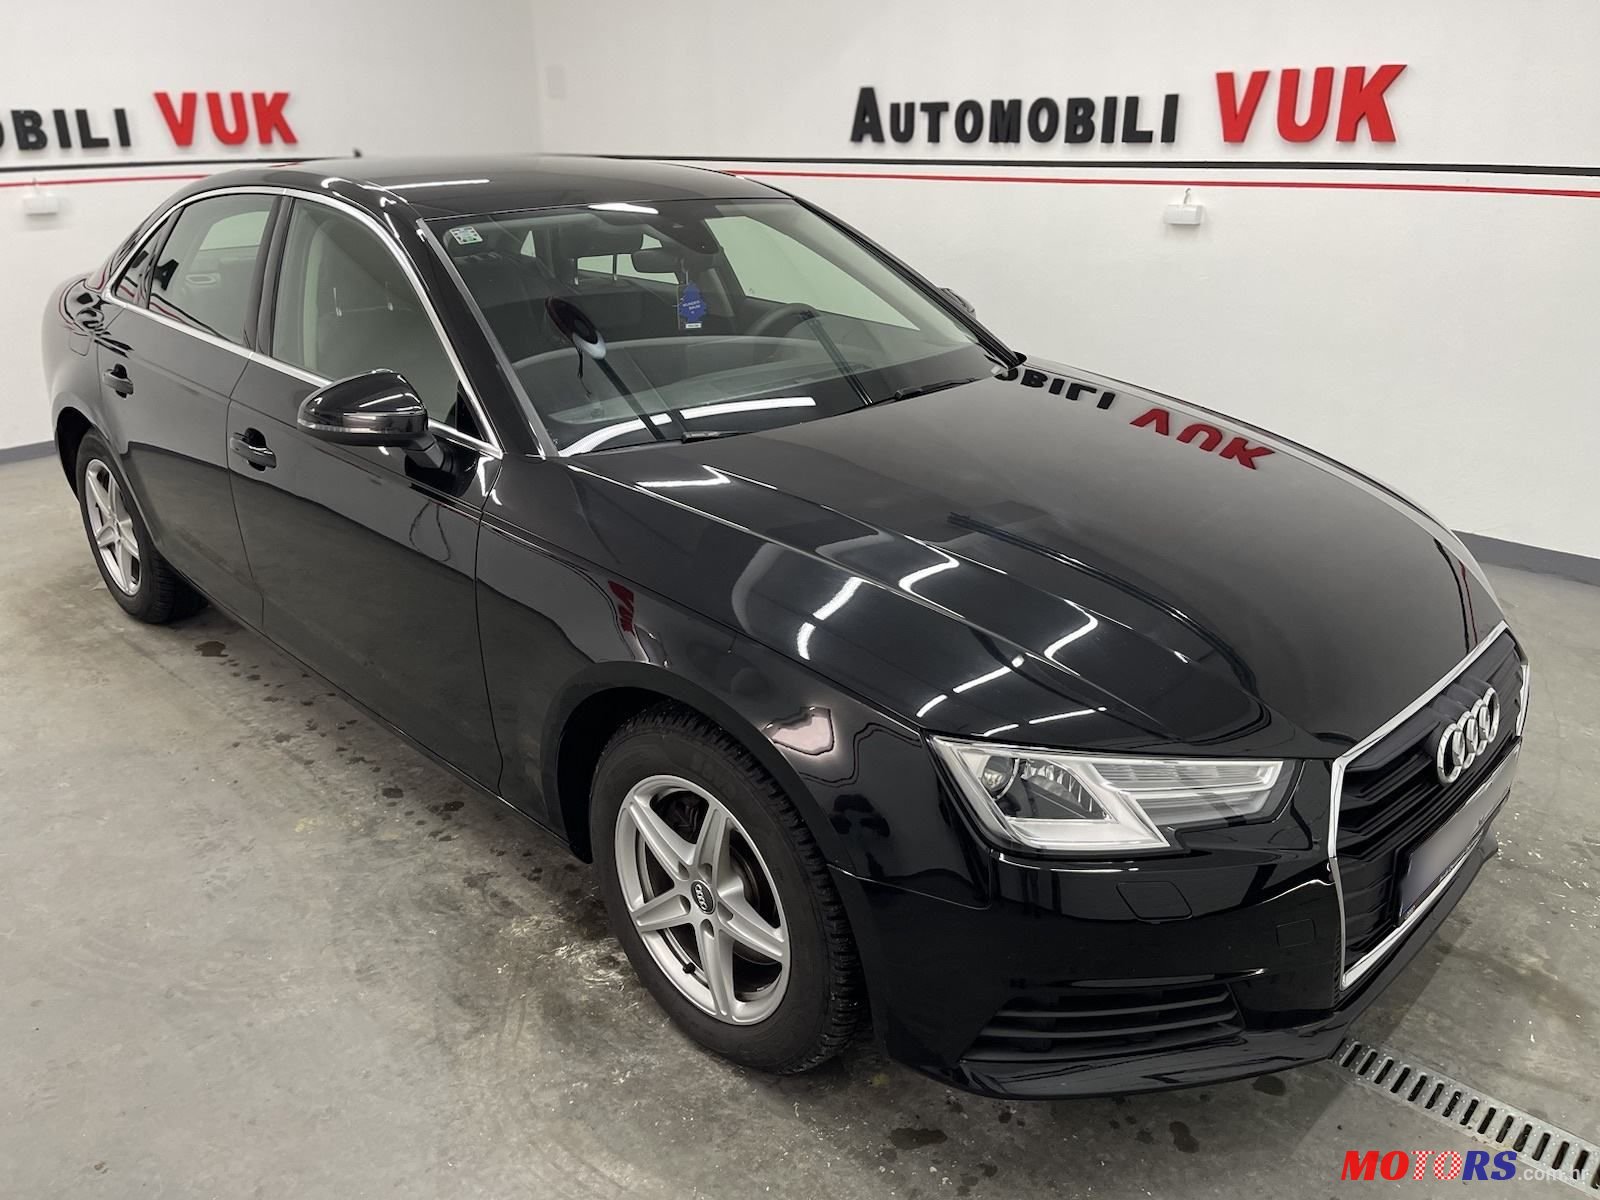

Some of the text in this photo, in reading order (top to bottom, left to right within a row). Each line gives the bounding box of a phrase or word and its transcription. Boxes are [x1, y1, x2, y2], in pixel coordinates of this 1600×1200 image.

[0, 92, 298, 150] BILI VUK
[850, 64, 1408, 144] AUTOMOBILI VUK
